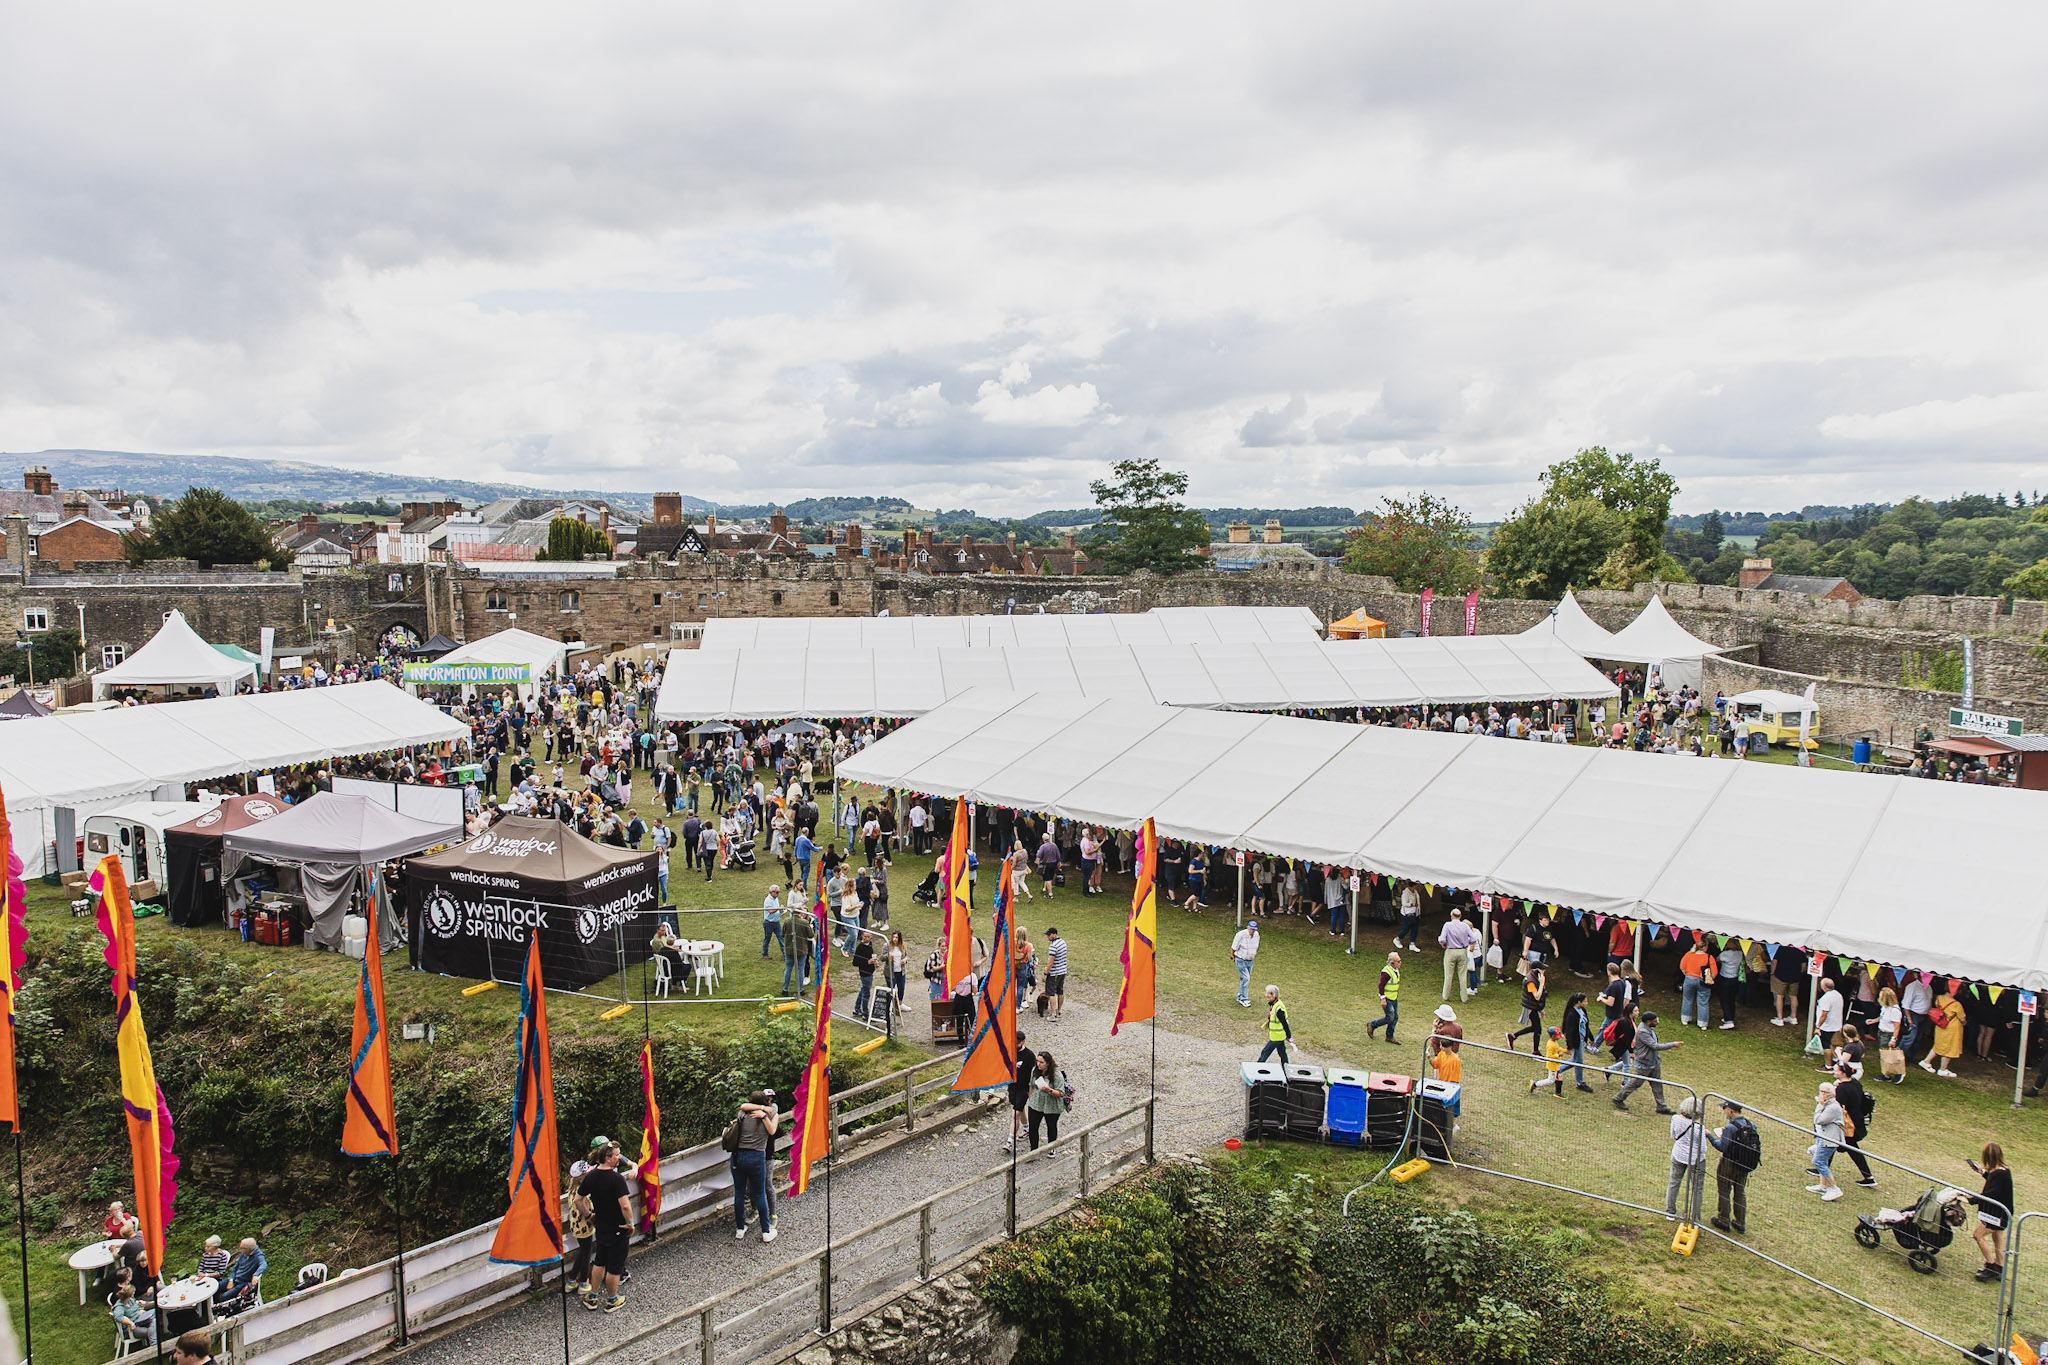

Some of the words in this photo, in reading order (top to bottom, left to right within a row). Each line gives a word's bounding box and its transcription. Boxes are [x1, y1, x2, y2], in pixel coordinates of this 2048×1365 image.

[410, 666, 487, 681] INFORMATION
[491, 666, 524, 681] POINT
[1962, 712, 2009, 728] RALPH'S
[489, 845, 532, 857] SPRING
[498, 837, 558, 855] wenlock
[450, 871, 490, 885] wenlock
[491, 877, 520, 889] SPRING
[583, 866, 620, 889] wenlock
[620, 862, 645, 877] SPRING
[600, 883, 655, 917] wenlock
[464, 900, 549, 929] wenlock
[602, 907, 639, 932] SPRING
[465, 918, 525, 943] SPRING
